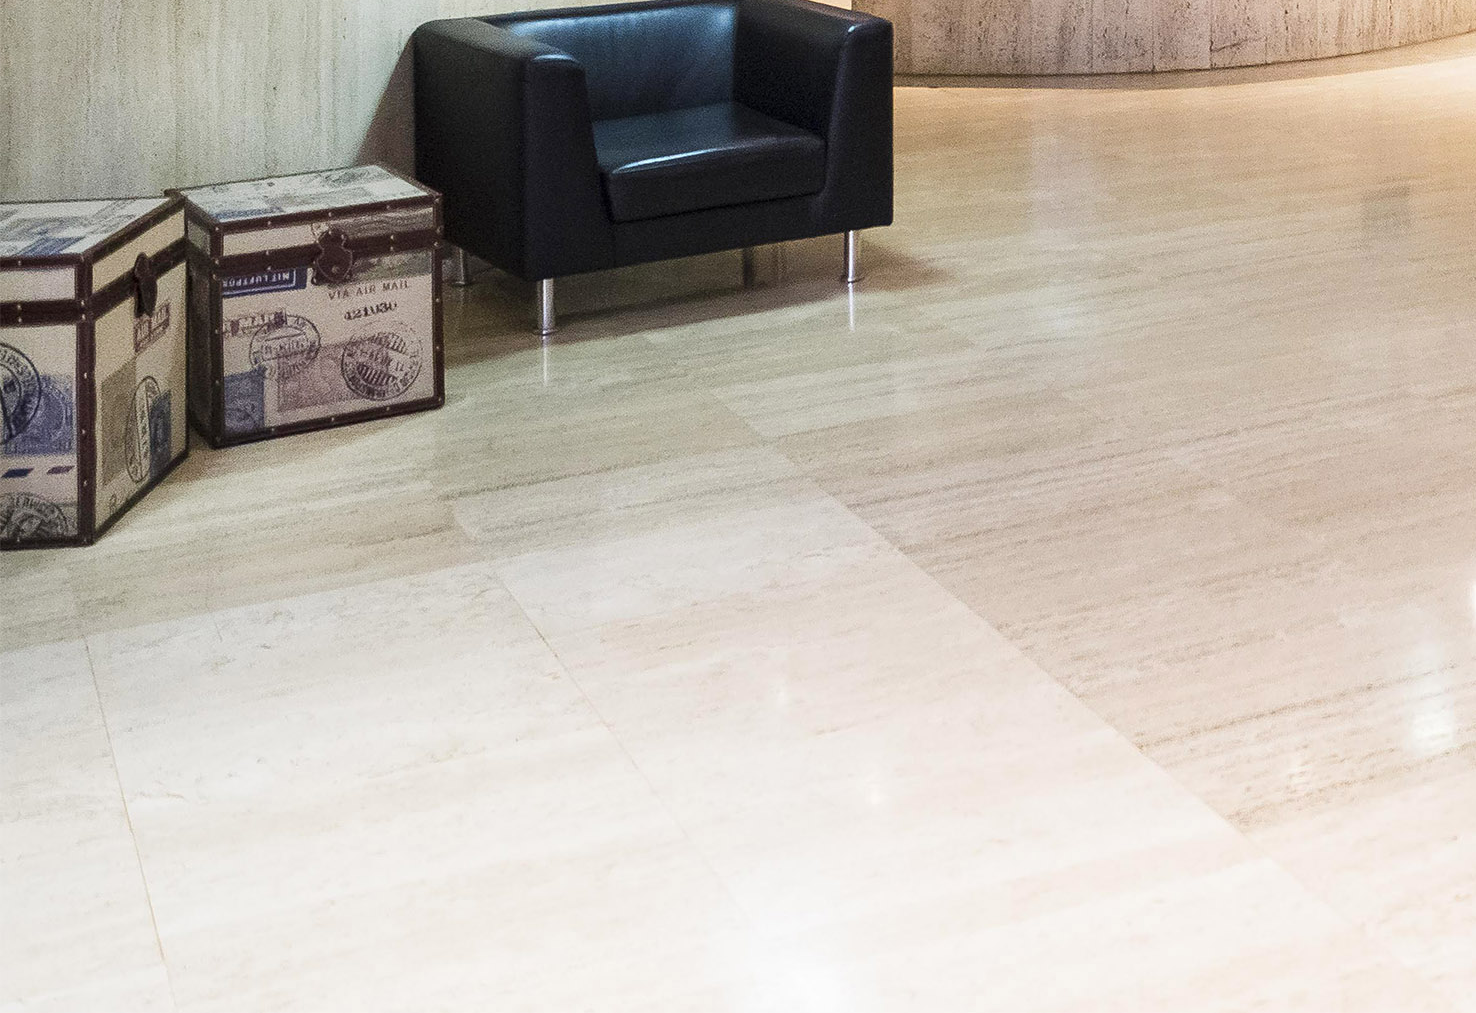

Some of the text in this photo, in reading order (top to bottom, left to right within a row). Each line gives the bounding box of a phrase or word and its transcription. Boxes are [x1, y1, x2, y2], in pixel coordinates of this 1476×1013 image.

[271, 272, 290, 282] MIT
[328, 280, 410, 300] VIA AIR MAIL
